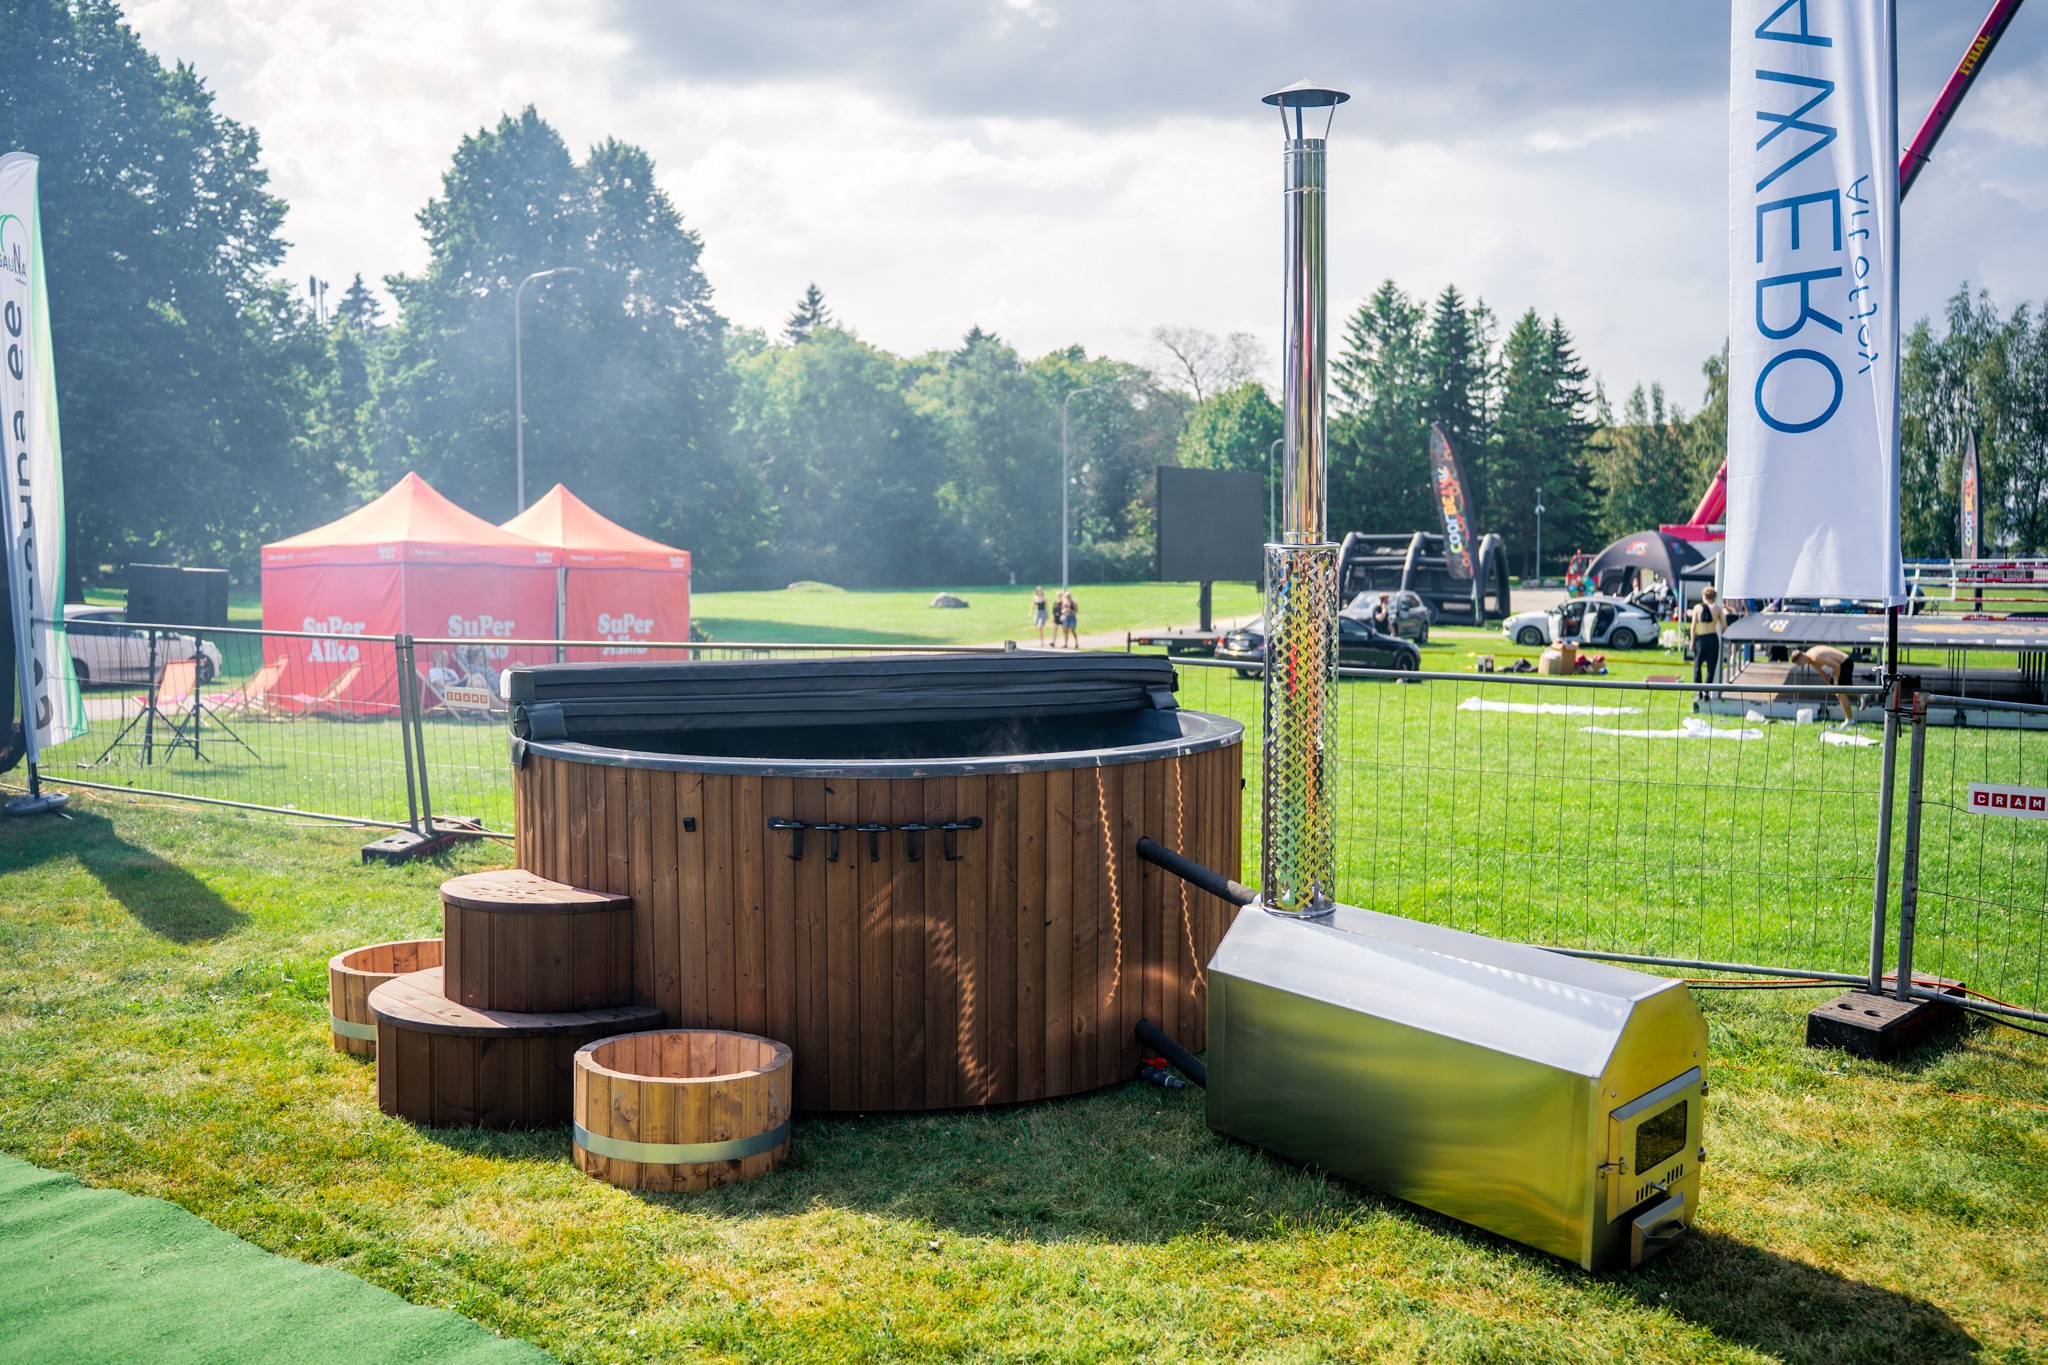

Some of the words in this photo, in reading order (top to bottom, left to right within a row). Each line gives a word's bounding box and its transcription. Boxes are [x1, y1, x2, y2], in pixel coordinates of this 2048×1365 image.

[1959, 34, 1991, 76] ITHAL
[303, 615, 365, 636] SuPer
[447, 614, 516, 637] SuPer
[597, 612, 655, 634] SuPer
[308, 638, 359, 663] Alko
[446, 691, 488, 704] CRAMO
[1976, 793, 2043, 810] CRAM
